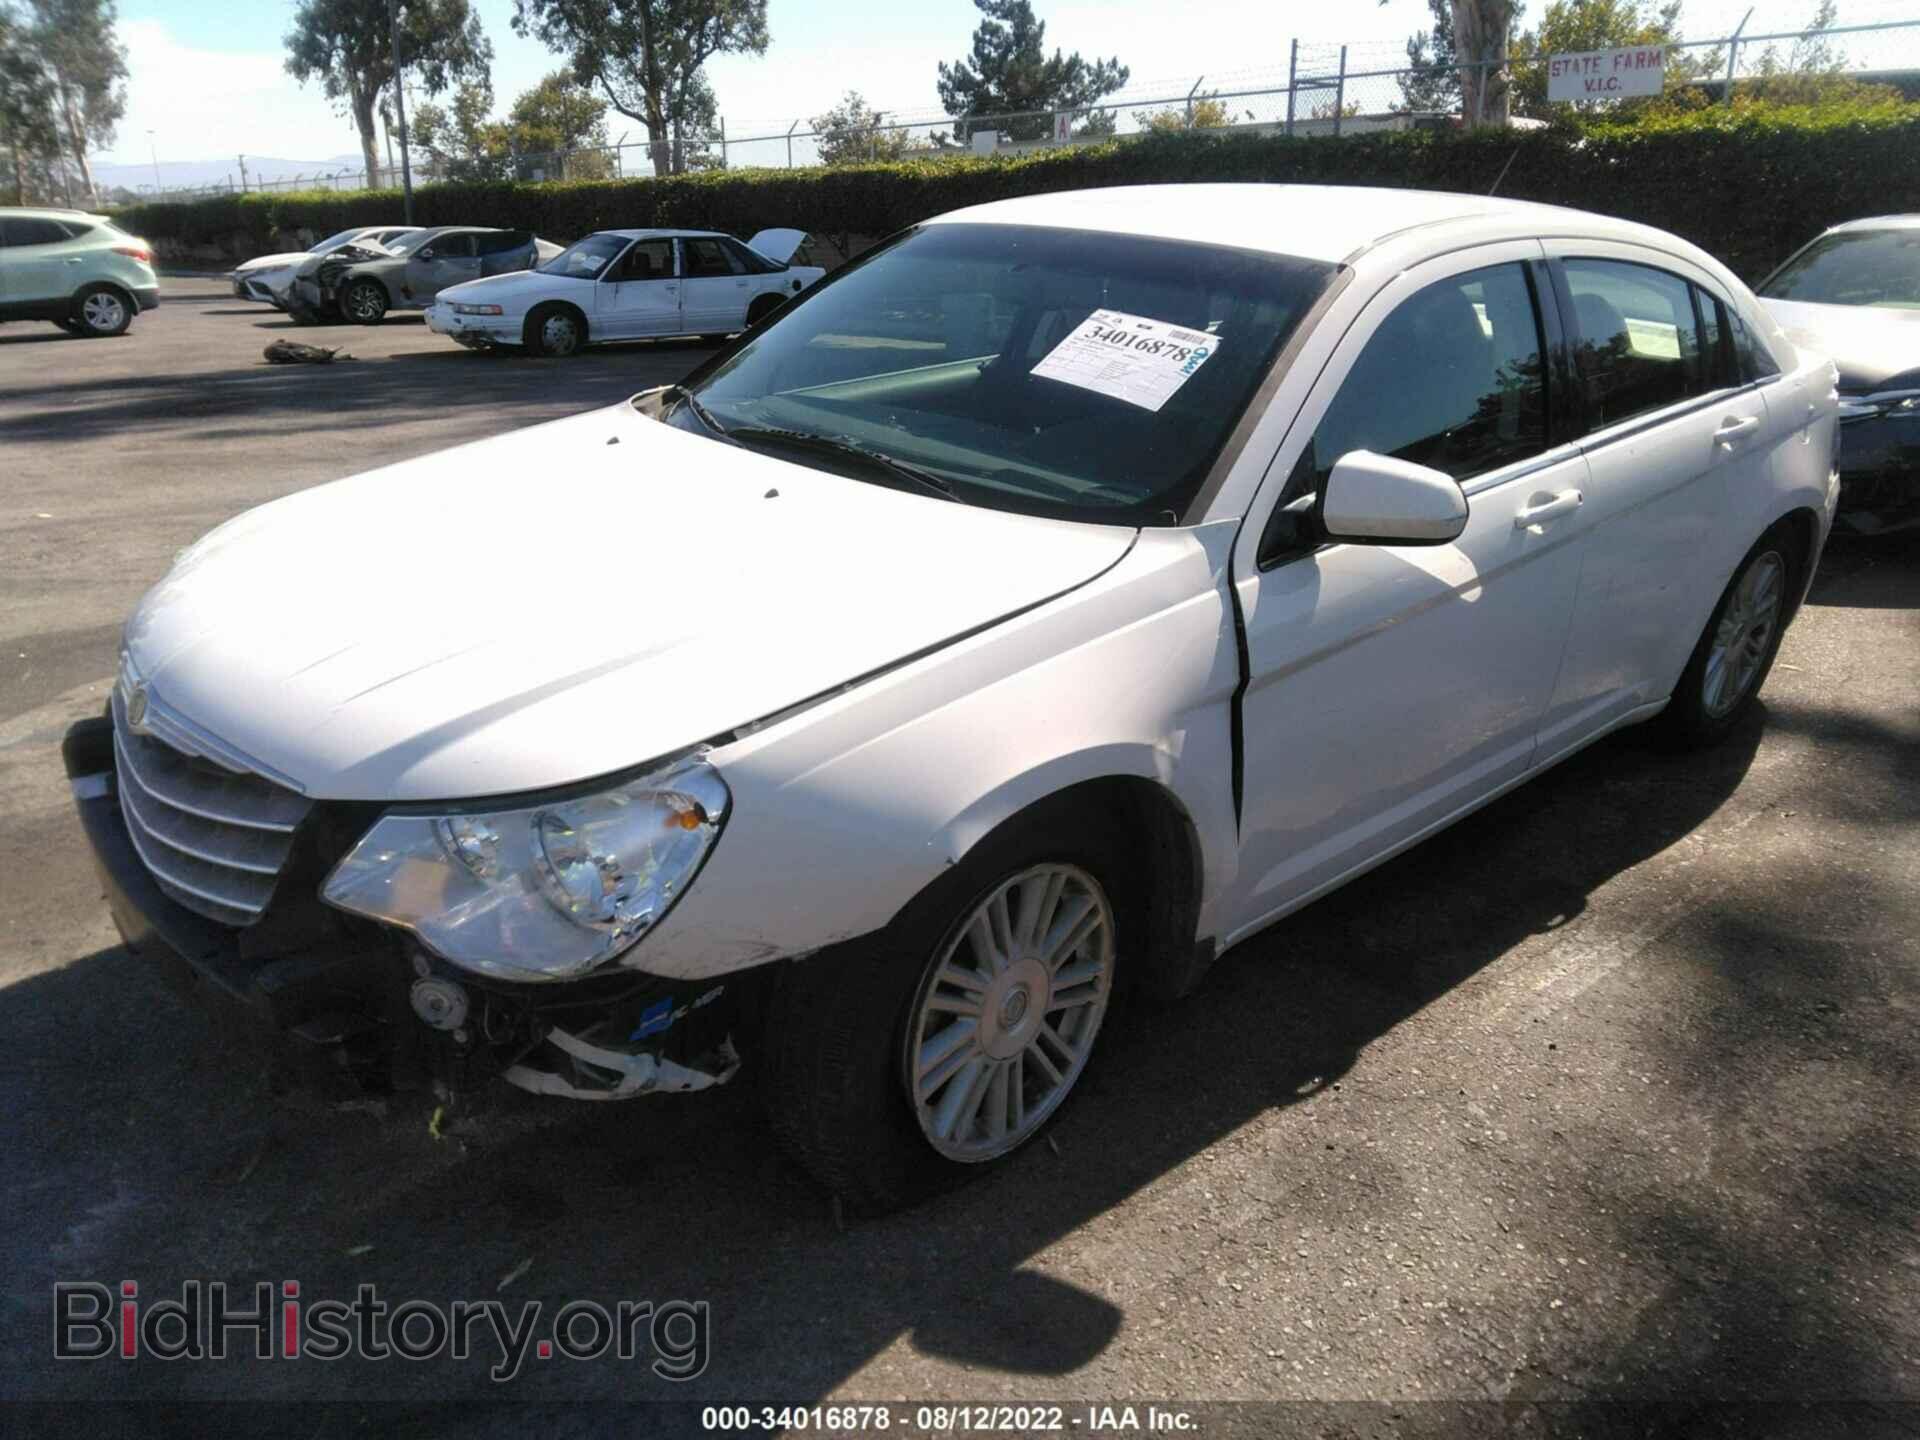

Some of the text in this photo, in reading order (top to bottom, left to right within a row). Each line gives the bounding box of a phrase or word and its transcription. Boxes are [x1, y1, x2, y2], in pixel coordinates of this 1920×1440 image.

[1551, 50, 1661, 77] STATE FARM
[1584, 77, 1622, 92] V.I.C.
[1084, 326, 1191, 361] 34016878
